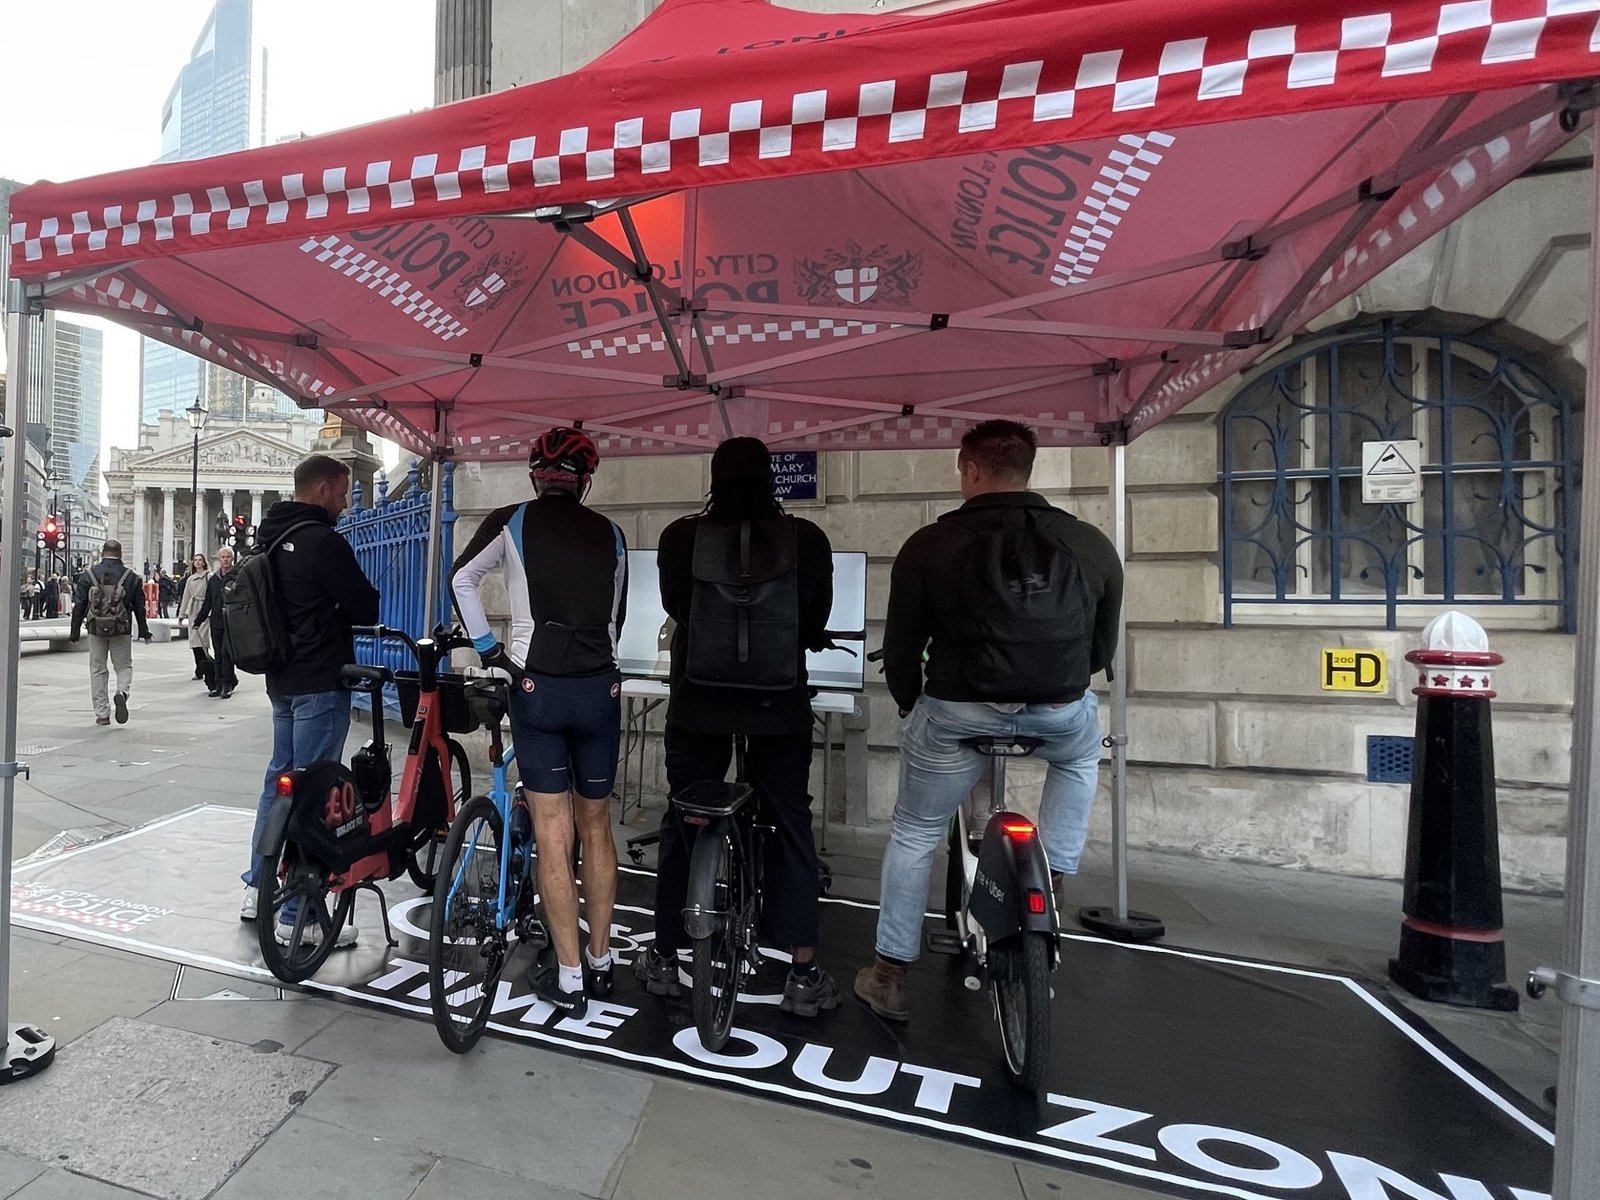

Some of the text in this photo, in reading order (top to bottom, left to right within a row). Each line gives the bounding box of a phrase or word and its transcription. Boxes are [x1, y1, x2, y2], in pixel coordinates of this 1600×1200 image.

[771, 463, 804, 473] MARY
[775, 474, 816, 484] CHURCH
[1326, 652, 1381, 687] HD
[36, 894, 161, 925] POLICE
[99, 897, 174, 916] LONDON
[367, 957, 1553, 1200] TIME OUT ZON
